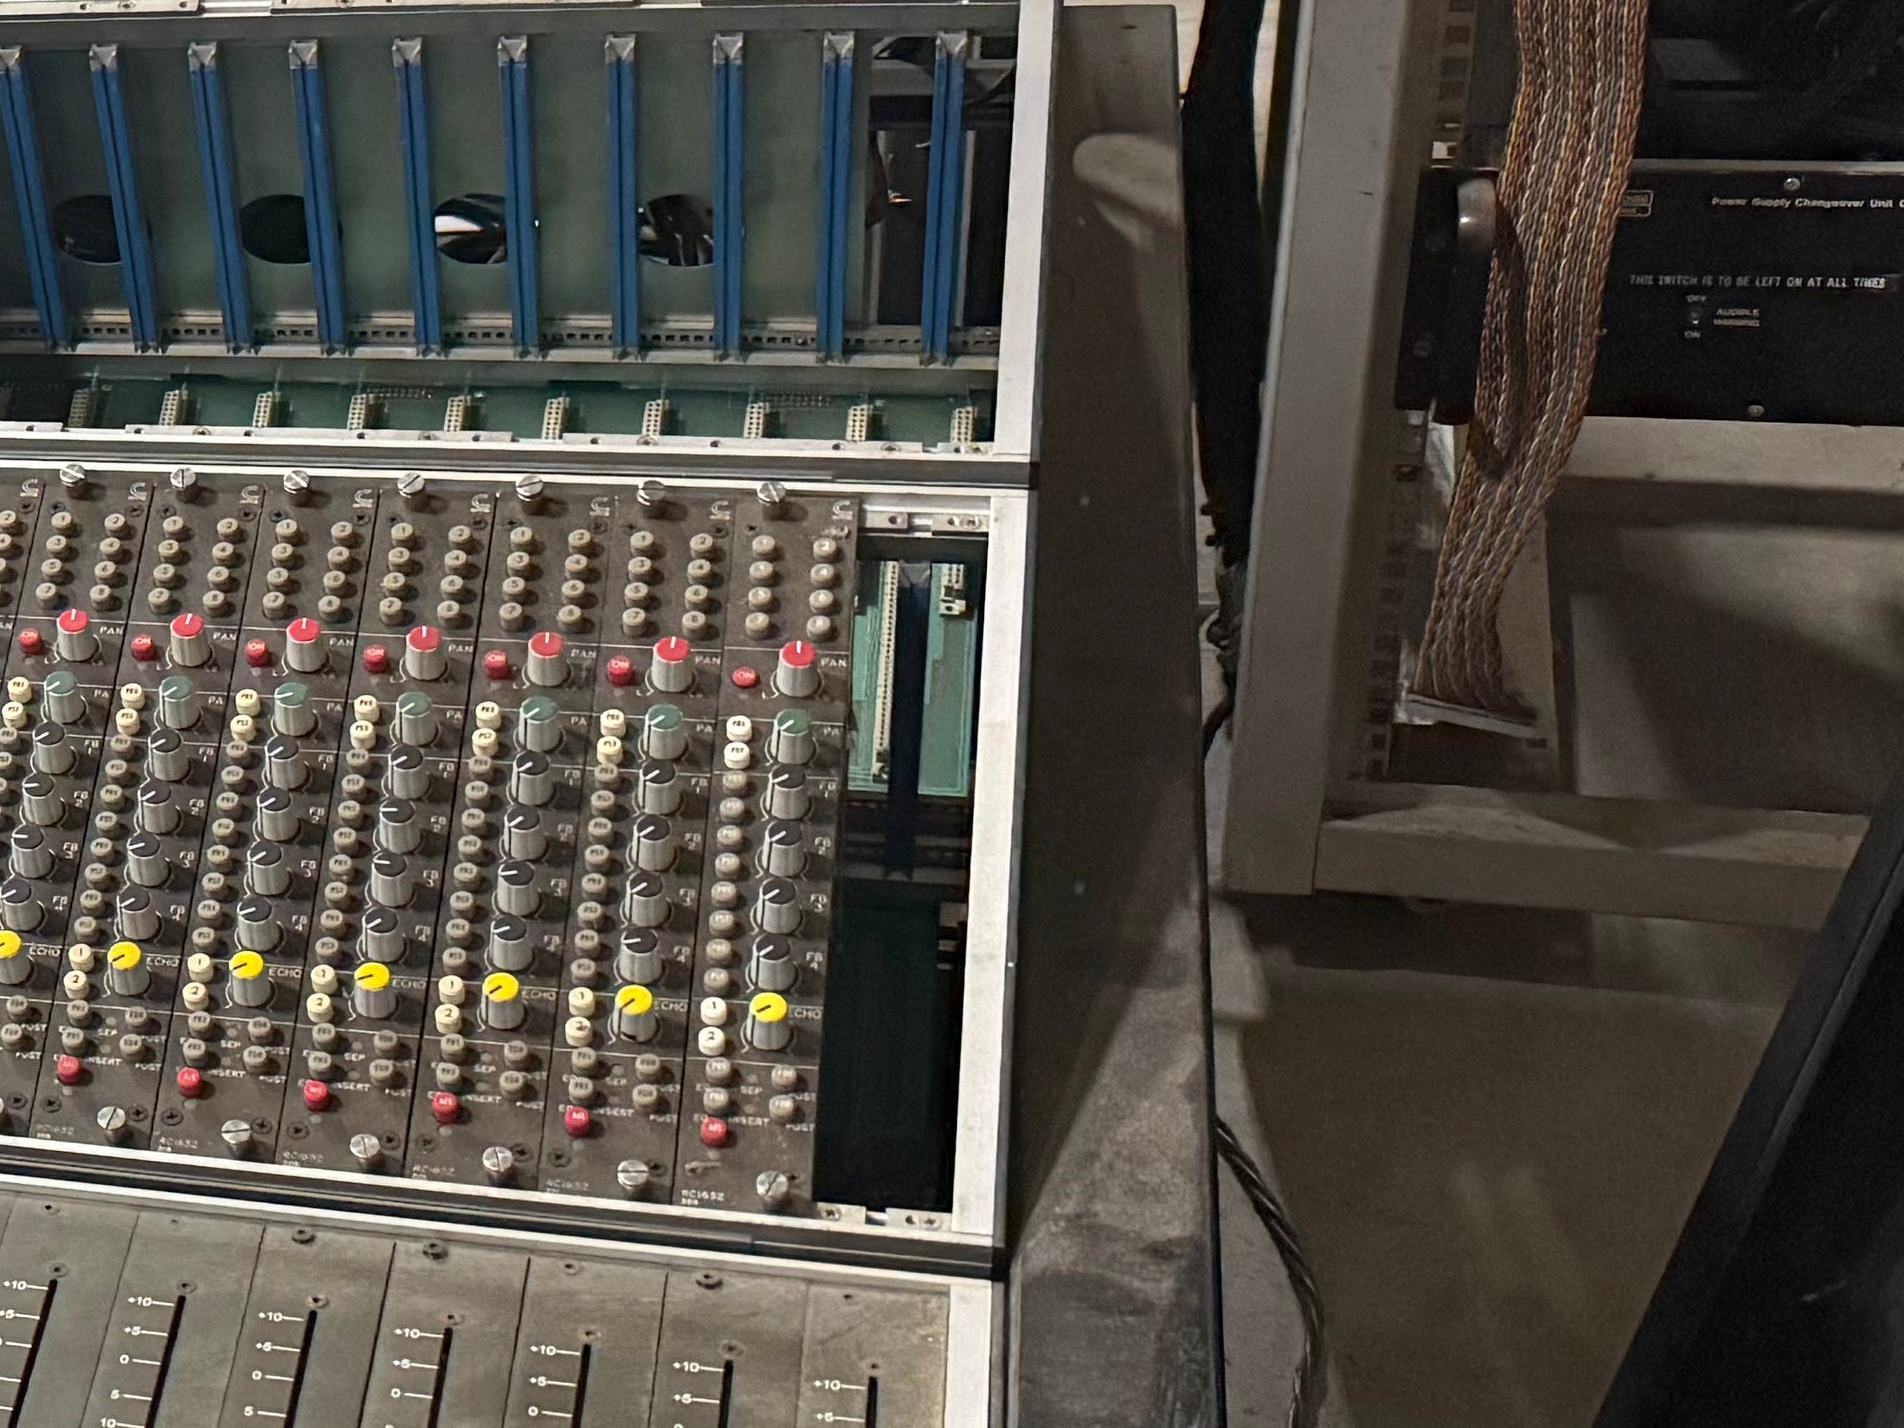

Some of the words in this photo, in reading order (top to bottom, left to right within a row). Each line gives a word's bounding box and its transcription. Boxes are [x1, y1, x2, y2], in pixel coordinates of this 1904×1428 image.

[1712, 197, 1746, 206] Power
[1752, 198, 1790, 208] Supply
[1795, 198, 1864, 208] Changeover
[1870, 199, 1893, 208] Unit
[1719, 276, 1732, 286] TO
[1737, 276, 1750, 286] BE
[1787, 277, 1802, 287] ON
[1808, 278, 1821, 287] AT
[1827, 278, 1846, 288] ALL
[695, 655, 721, 665] PAN
[821, 658, 846, 668] PAN
[146, 957, 180, 968] ECHO
[269, 968, 303, 978] ECHO
[393, 980, 426, 989] ECHO
[3, 1280, 27, 1290] +10
[128, 1296, 152, 1307] +10
[394, 1328, 420, 1339] +10
[530, 1345, 556, 1355] +10
[119, 1355, 129, 1364] 0
[673, 1361, 700, 1372] +10
[814, 1380, 841, 1390] +10
[111, 1390, 120, 1399] 5
[391, 1388, 401, 1398] 0
[528, 1406, 538, 1416] 0
[100, 1418, 117, 1428] 10
